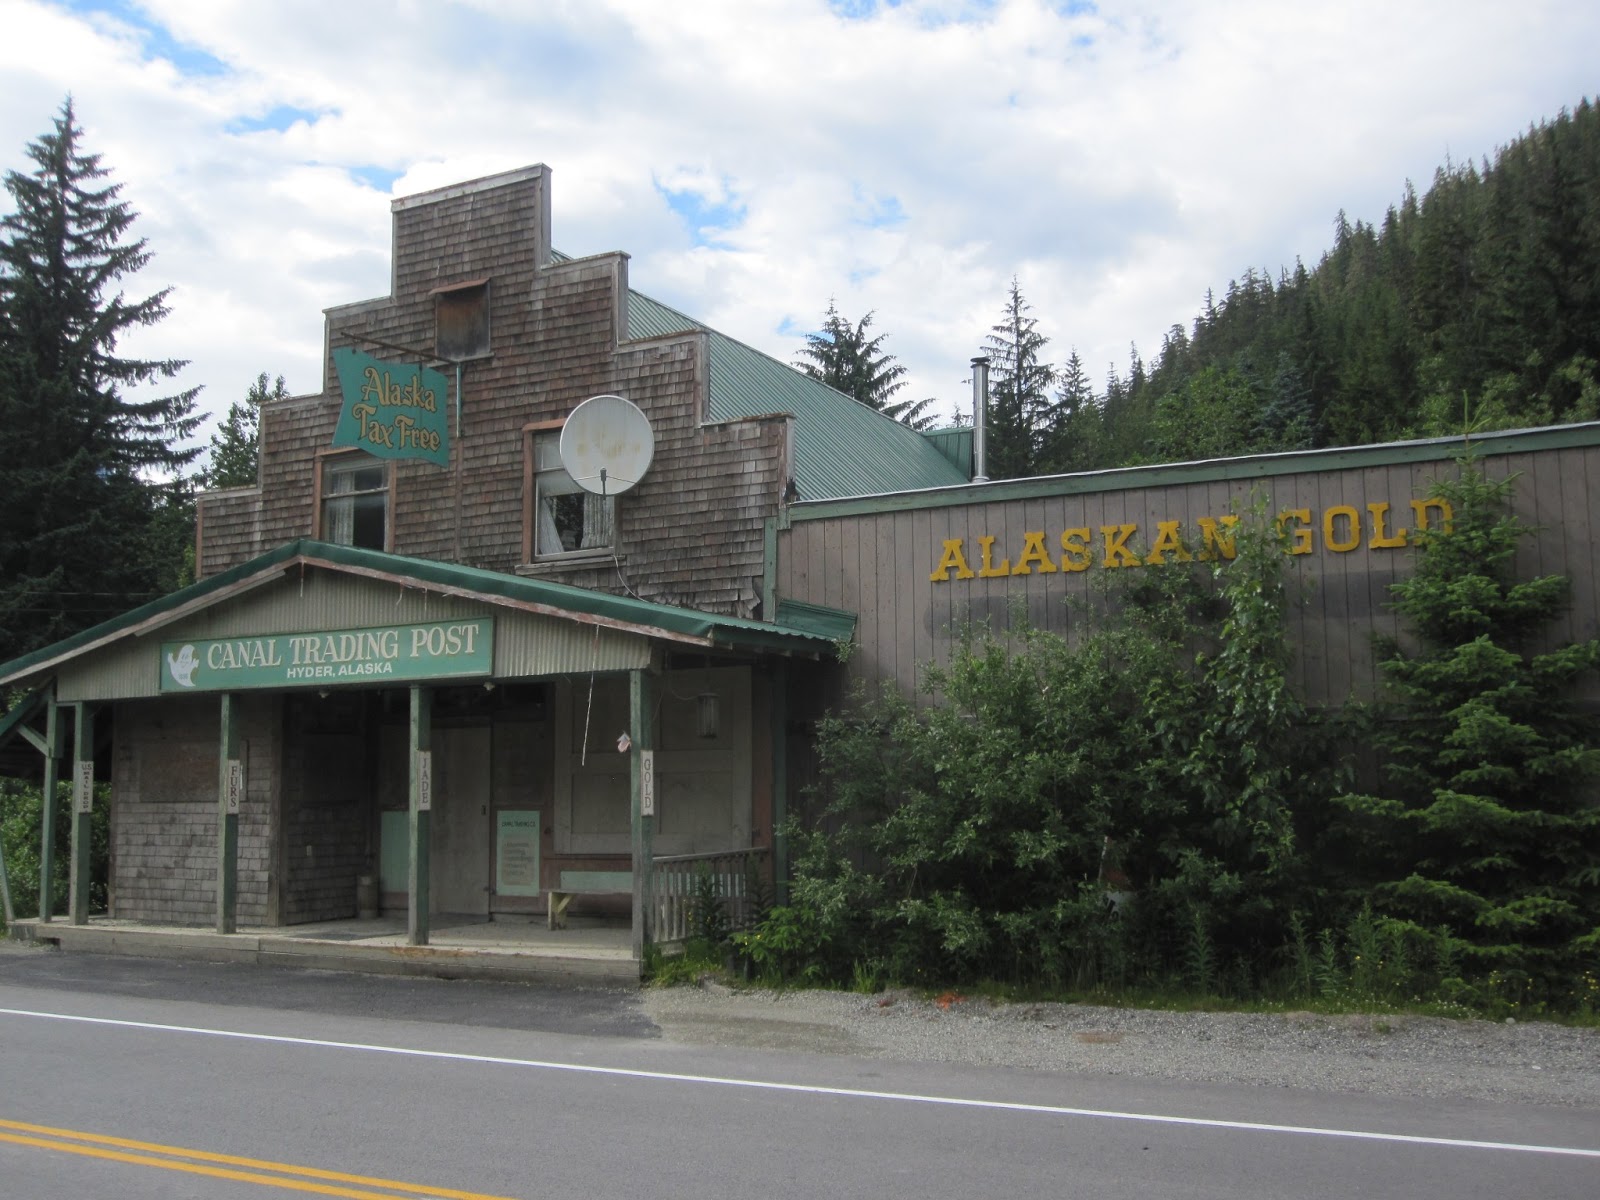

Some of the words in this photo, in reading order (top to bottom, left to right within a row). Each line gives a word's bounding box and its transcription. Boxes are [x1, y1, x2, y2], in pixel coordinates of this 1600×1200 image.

[361, 366, 437, 412] Alaska
[352, 403, 394, 448] Tax
[394, 414, 441, 451] Free
[929, 515, 1240, 582] ALASKAN
[1276, 498, 1454, 555] GOLD
[207, 639, 281, 669] CANAL
[289, 630, 399, 665] TRADING
[410, 624, 479, 657] POST
[287, 665, 336, 678] HYDER,
[338, 662, 392, 675] ALASKA
[230, 766, 238, 807] FURS
[421, 758, 429, 804] JADE
